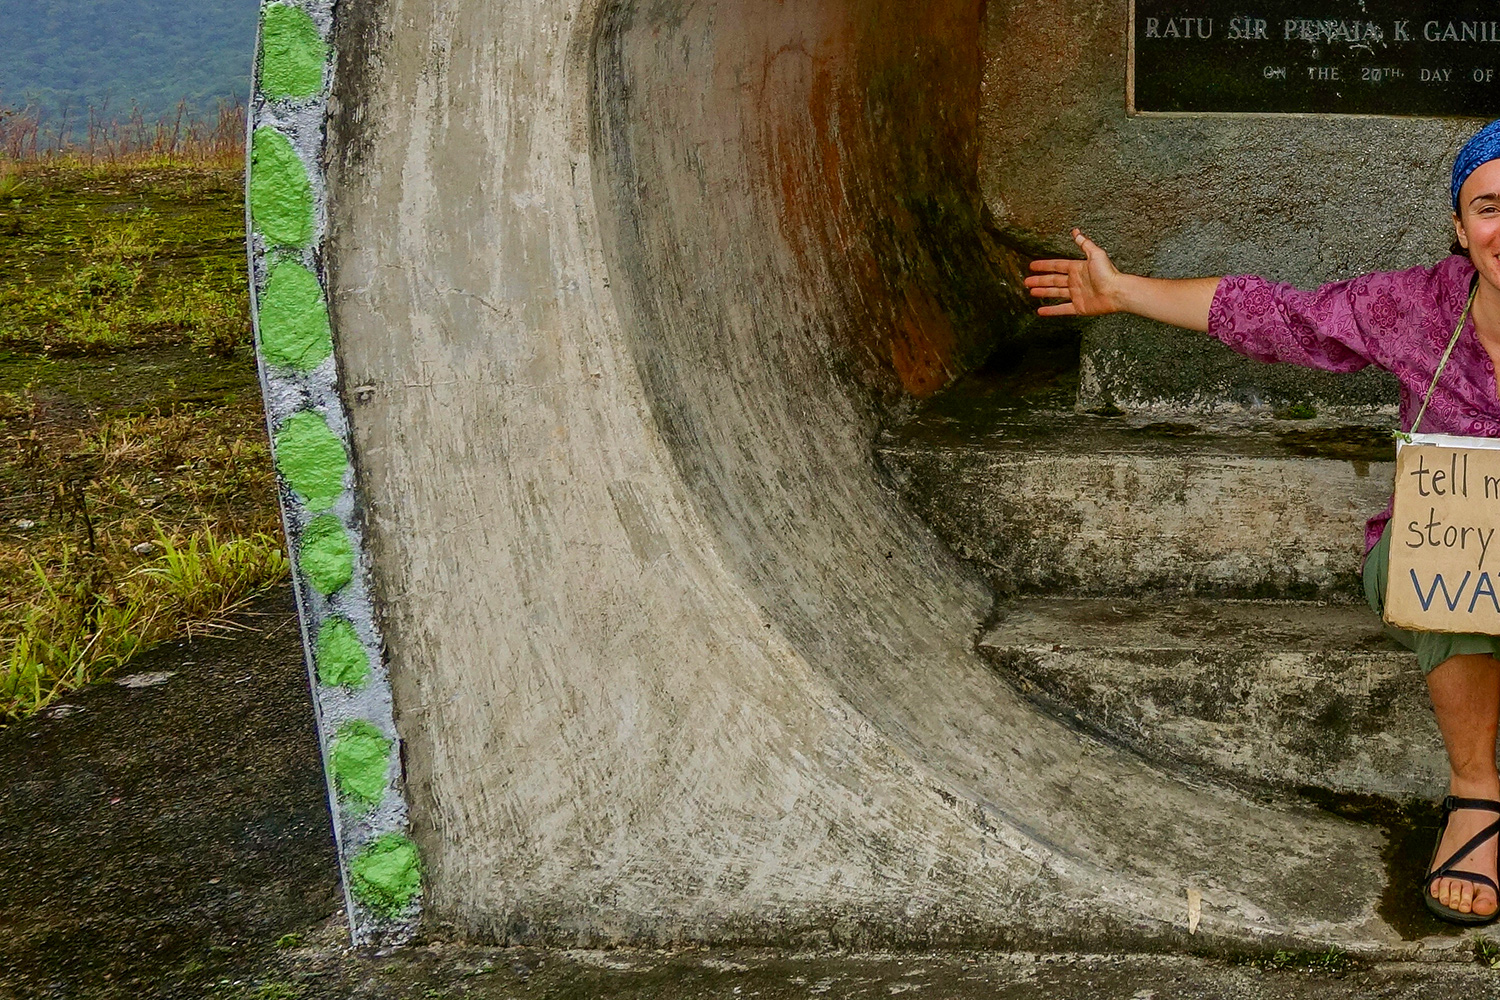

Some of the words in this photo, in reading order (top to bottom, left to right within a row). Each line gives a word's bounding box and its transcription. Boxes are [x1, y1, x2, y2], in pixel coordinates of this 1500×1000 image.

[1145, 17, 1214, 39] RATU
[1227, 18, 1269, 40] SIR
[1307, 66, 1340, 81] THE
[1420, 68, 1452, 82] DAY
[1473, 69, 1494, 83] OF
[1410, 453, 1468, 498] tell
[1405, 507, 1495, 570] story
